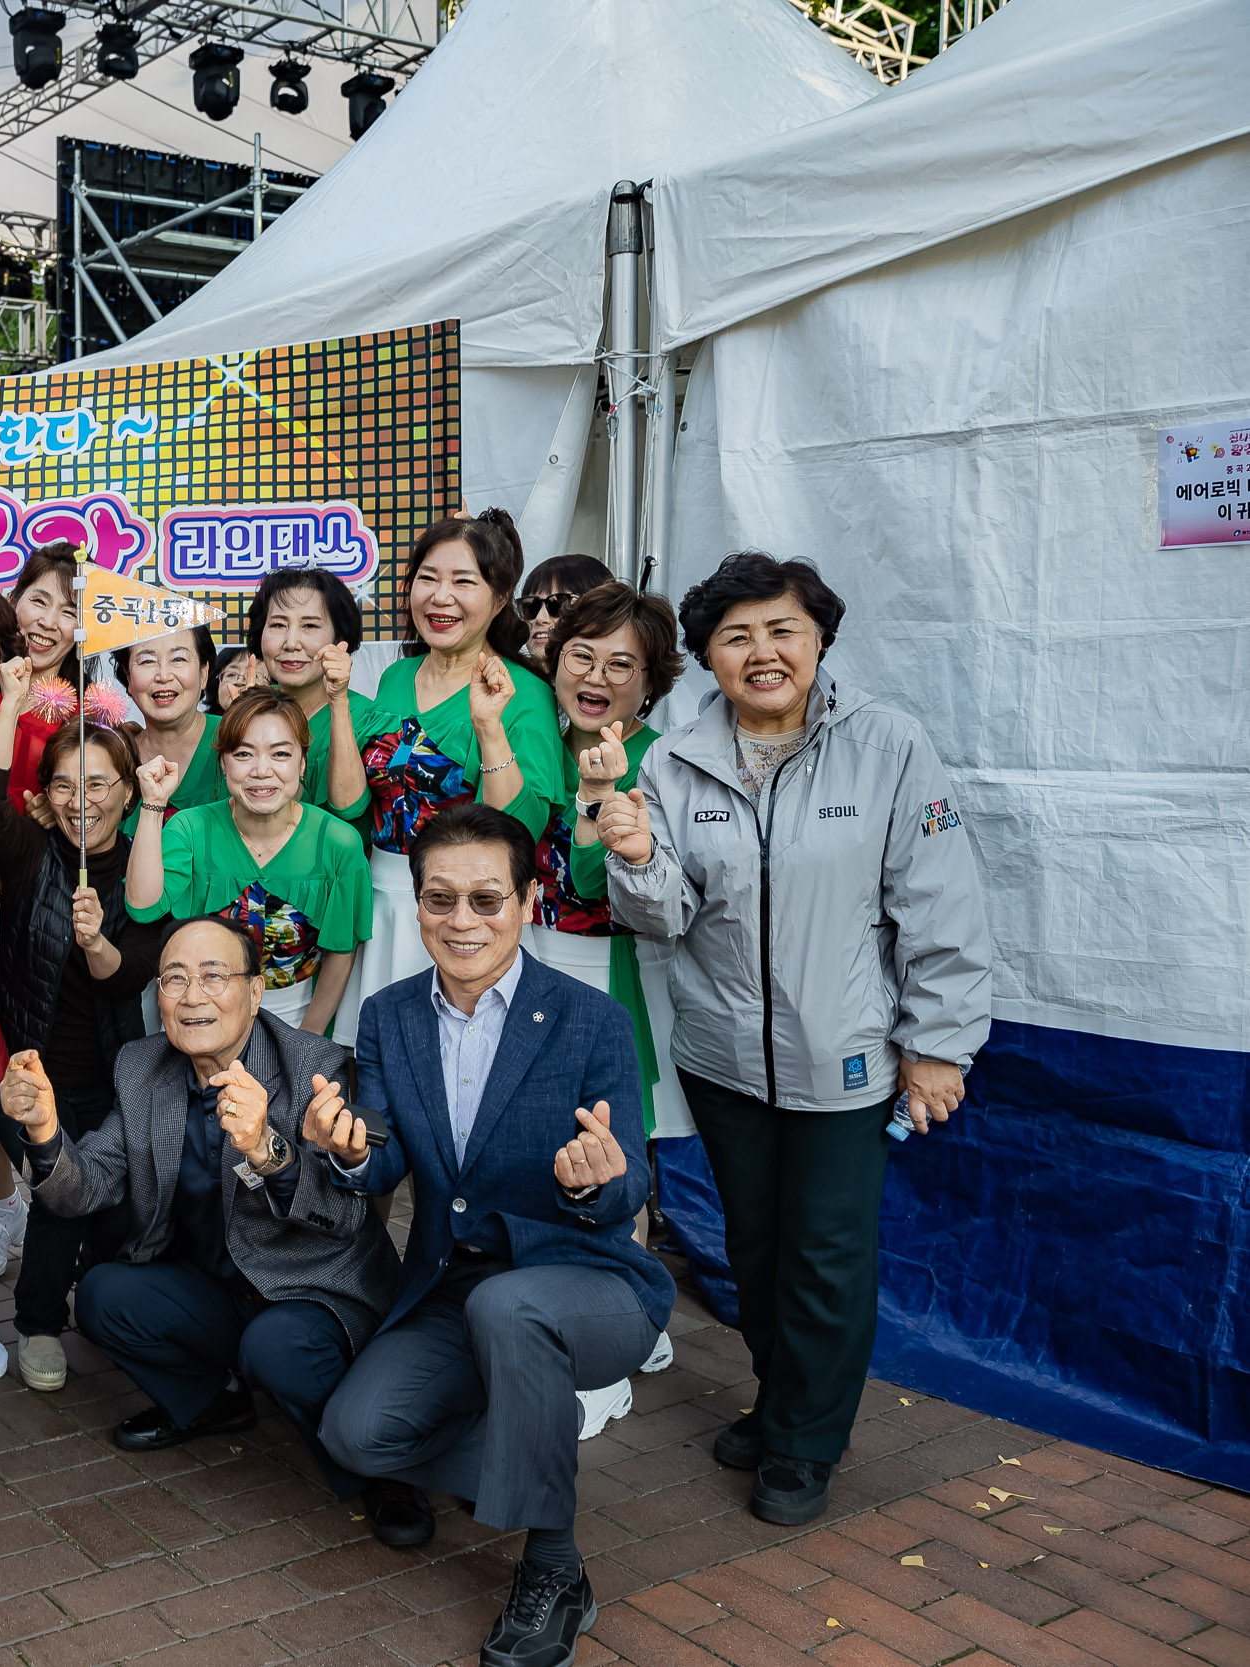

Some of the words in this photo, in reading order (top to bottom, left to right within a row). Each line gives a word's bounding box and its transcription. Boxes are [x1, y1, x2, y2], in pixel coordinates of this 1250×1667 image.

[1176, 478, 1240, 501] 에어로빅
[179, 521, 358, 571] 라인댄스
[92, 594, 182, 628] 중곡1동
[696, 811, 728, 822] RYN
[818, 805, 860, 819] SEOUL
